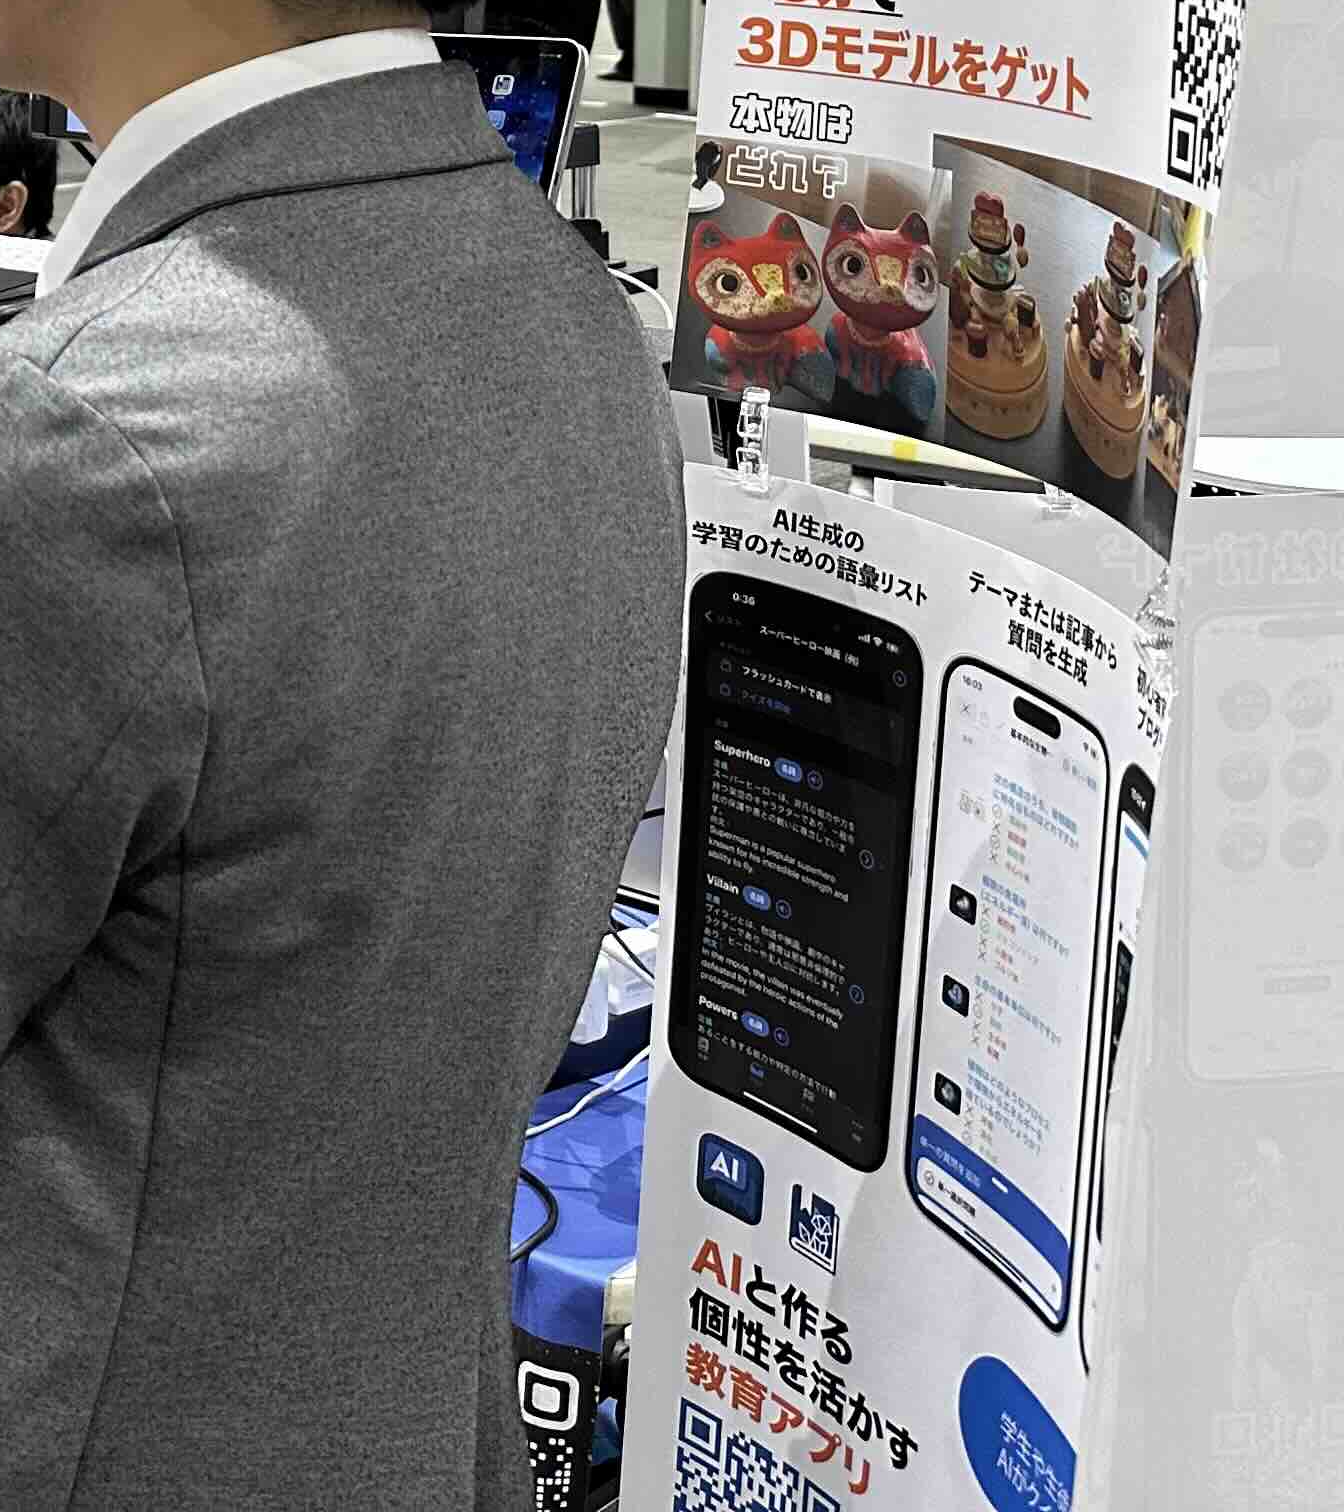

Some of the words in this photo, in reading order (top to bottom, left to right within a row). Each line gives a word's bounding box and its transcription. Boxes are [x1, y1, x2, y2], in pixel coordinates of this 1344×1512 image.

[737, 16, 1092, 114] 3Dモデルをゲット
[730, 92, 854, 145] 本物は
[692, 519, 928, 607] 学習のための語彙リスト
[772, 508, 865, 553] AI生成の
[969, 571, 1117, 670] テーマまたは記事から
[1007, 619, 1088, 688] 質問を生成
[714, 739, 771, 768] Superhero
[707, 873, 739, 895] Villain
[698, 995, 738, 1020] Powers
[711, 1151, 739, 1182] AI
[690, 1238, 853, 1365] AIと作る
[689, 1287, 919, 1470] 個性を活かす
[686, 1342, 872, 1496] 教育アプリ
